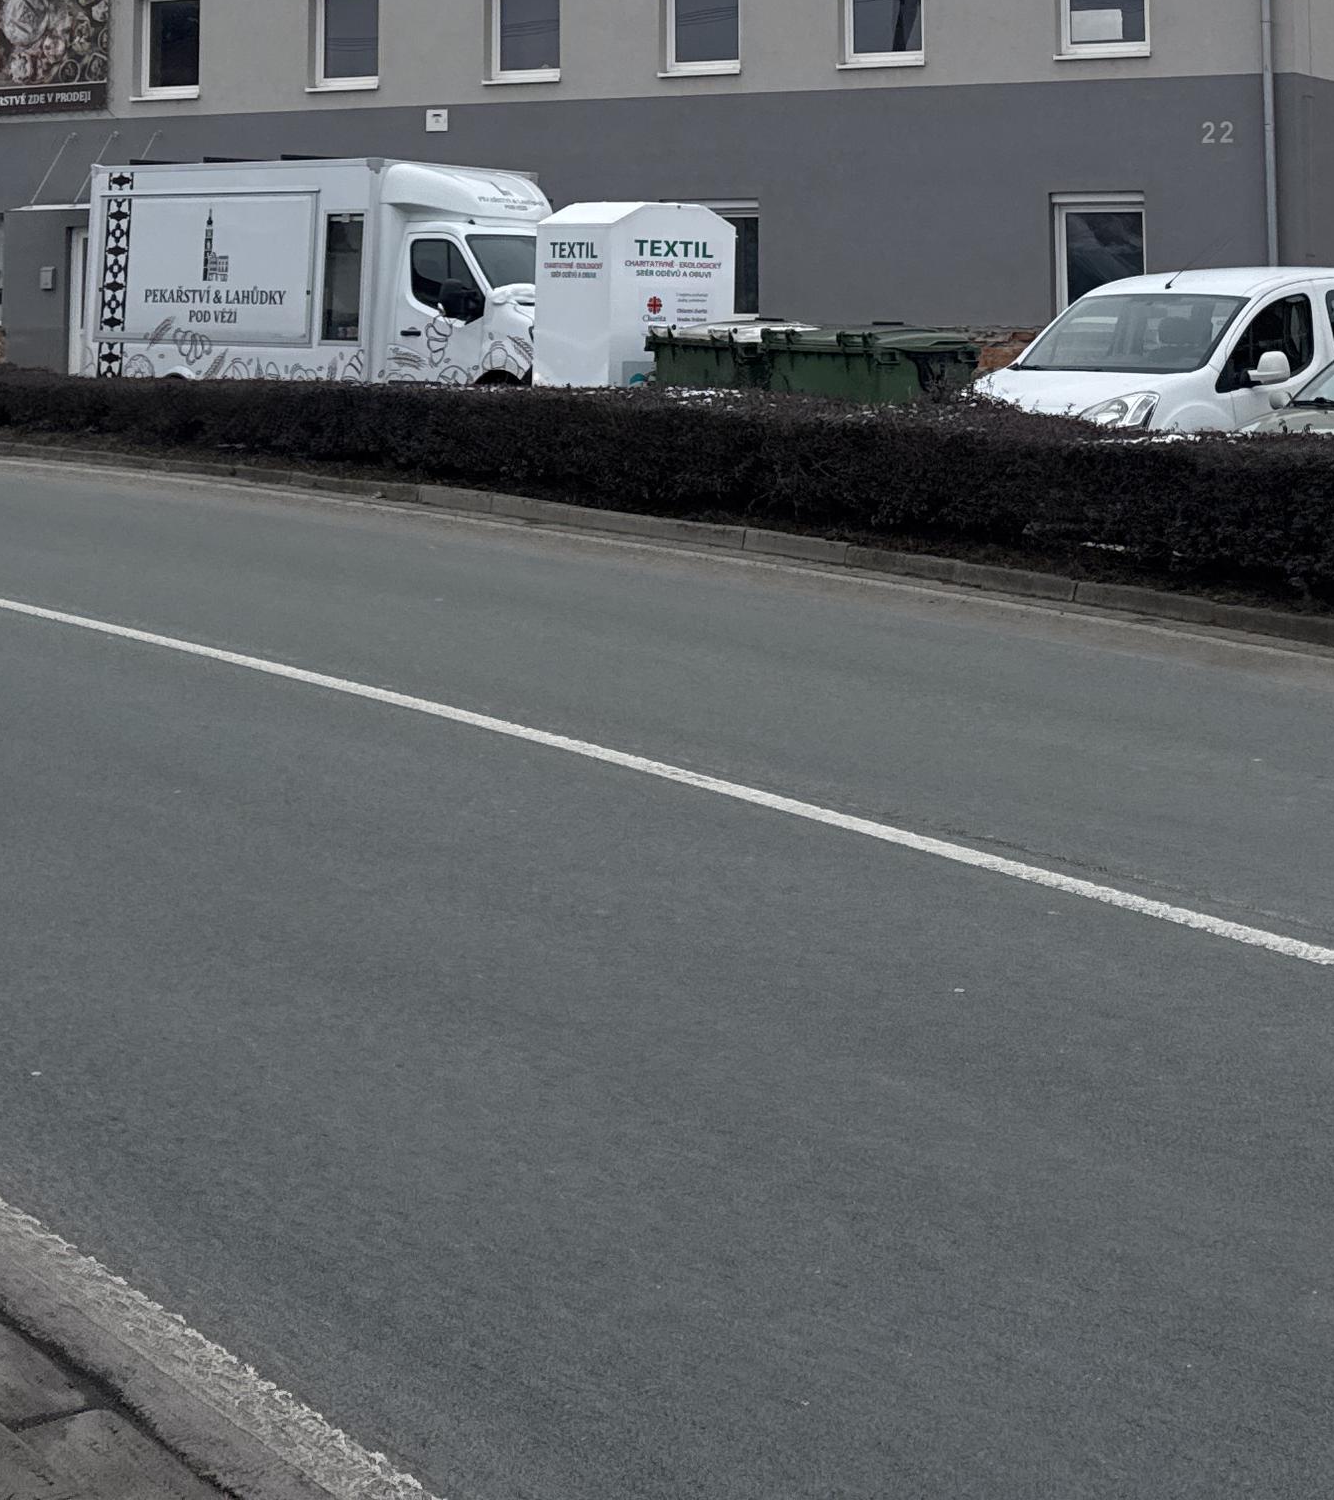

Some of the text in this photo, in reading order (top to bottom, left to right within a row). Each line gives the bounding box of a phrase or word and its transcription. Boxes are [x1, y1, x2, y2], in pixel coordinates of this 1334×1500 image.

[27, 93, 45, 106] ZDE
[46, 92, 54, 104] V
[1202, 121, 1234, 143] 22
[550, 242, 598, 259] TEXTIL
[634, 239, 714, 259] TEXTIL
[144, 285, 287, 305] PEKAŘSTVÍ & LAHŮDKY
[188, 308, 237, 324] POD VĚŽÍ
